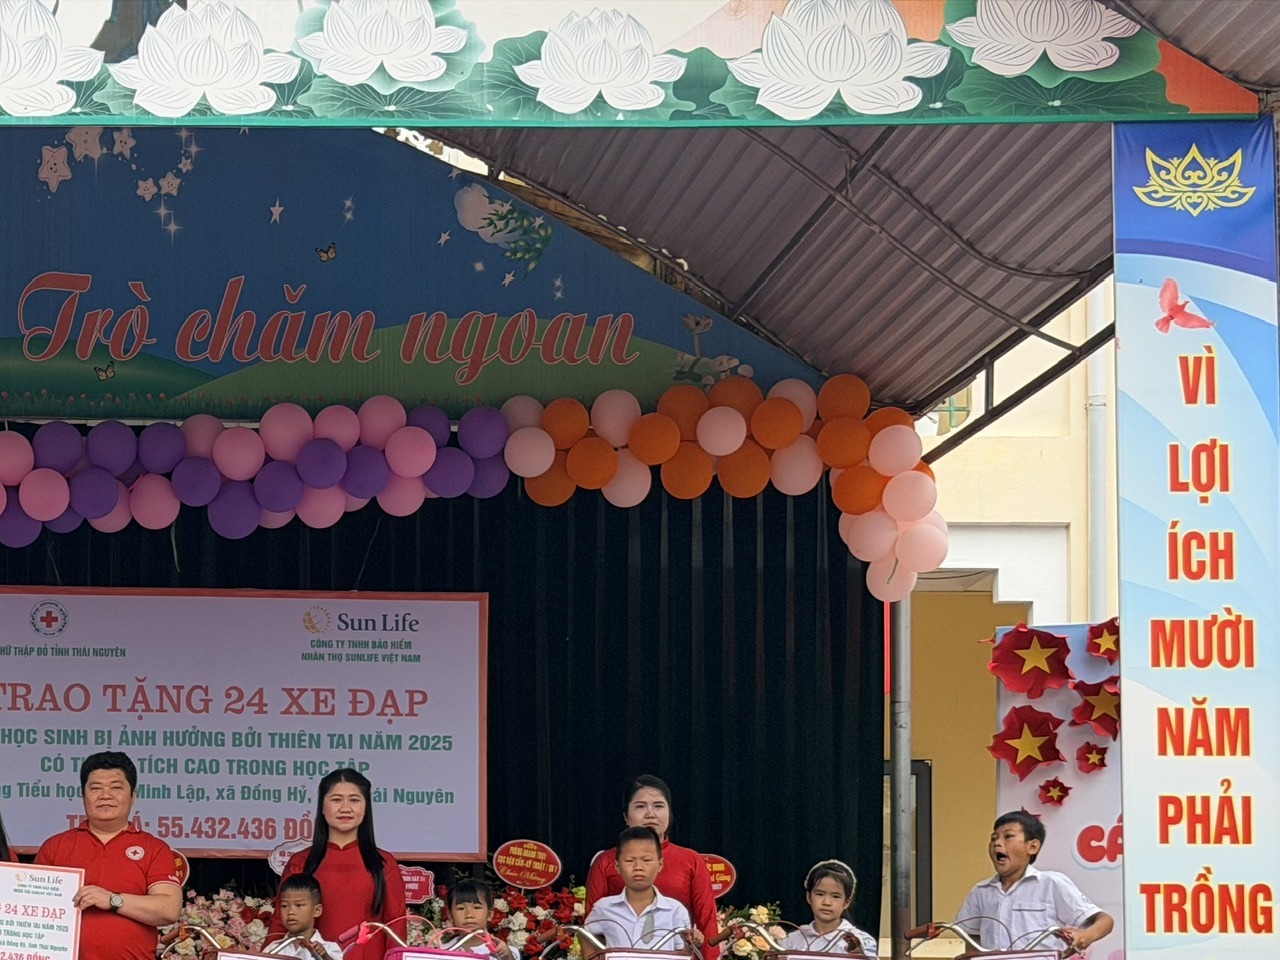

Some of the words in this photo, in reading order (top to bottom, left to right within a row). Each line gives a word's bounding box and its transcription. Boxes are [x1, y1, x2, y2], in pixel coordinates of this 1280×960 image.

[18, 271, 156, 364] Trò
[174, 275, 382, 364] chăm
[400, 308, 641, 385] ngoan
[1178, 345, 1216, 405] VÌ
[1169, 438, 1230, 504] LỢI
[1168, 520, 1234, 580] ÍCH
[337, 613, 377, 631] Sun
[382, 613, 419, 632] Life
[14, 646, 34, 658] THẬP
[52, 643, 69, 657] TỈNH
[72, 645, 90, 657] THÁI
[93, 646, 126, 657] NGUYÊN
[310, 639, 334, 648] CÔNG
[336, 640, 345, 649] TY
[348, 640, 369, 649] TNHH
[372, 639, 388, 649] BẢO
[1150, 606, 1256, 669] MƯỜI
[301, 652, 325, 661] NHÂN
[327, 653, 342, 663] THỌ
[345, 653, 379, 662] SUNLIFE
[382, 652, 399, 663] VIỆT
[401, 654, 421, 663] NAM
[102, 676, 213, 721] TẶNG
[224, 685, 268, 714] 24
[280, 688, 335, 715] XE
[347, 689, 428, 725] ĐẠP
[1, 728, 37, 747] HỌC
[44, 729, 88, 745] SINH
[94, 730, 112, 749] BỊ
[118, 724, 156, 746] ẢNH
[162, 725, 225, 748] HƯỞNG
[232, 726, 262, 748] BỞI
[268, 730, 321, 748] THIÊN
[327, 733, 353, 749] TAI
[359, 731, 402, 749] NĂM
[408, 735, 453, 751] 2025
[1157, 696, 1251, 756] NĂM
[41, 753, 65, 772] CÓ
[137, 755, 179, 774] TÍCH
[184, 758, 220, 775] CAO
[226, 759, 286, 776] TRONG
[293, 760, 329, 779] HỌC
[17, 779, 50, 797] Tiểu
[177, 784, 210, 803] Lập,
[216, 785, 235, 800] xã
[241, 783, 282, 802] Đồng
[394, 787, 454, 805] Nguyên
[157, 816, 277, 840] 55.432.436
[284, 811, 313, 840] ĐỒ
[1158, 778, 1252, 844] PHẢI
[29, 874, 46, 884] Sun
[47, 875, 63, 885] Life
[5, 904, 18, 915] 24
[22, 905, 38, 916] XE
[41, 907, 66, 921] ĐẠP
[1139, 866, 1273, 934] TRỒNG
